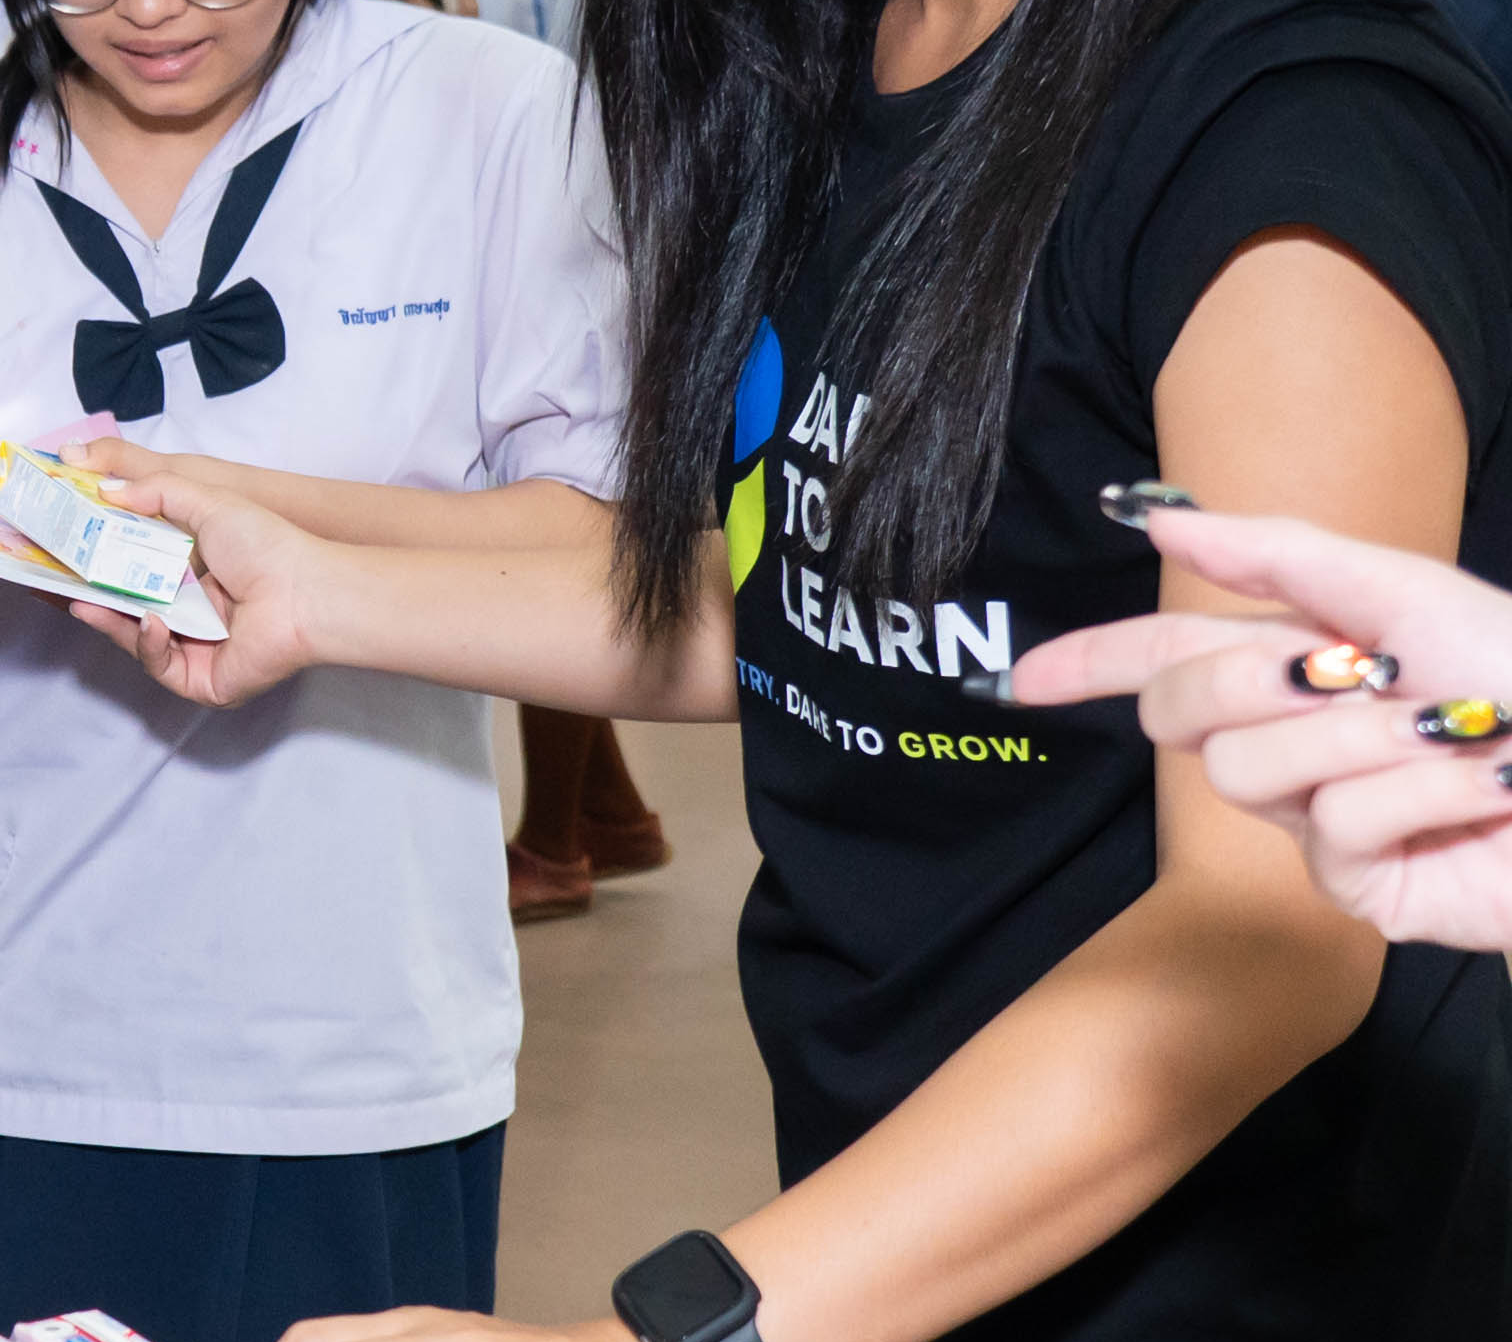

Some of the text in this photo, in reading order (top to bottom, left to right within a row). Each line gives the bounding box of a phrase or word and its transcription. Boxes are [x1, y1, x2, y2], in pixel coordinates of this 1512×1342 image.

[787, 371, 872, 465] DA
[782, 459, 832, 553] TO
[781, 554, 1012, 678] LEARN
[836, 719, 885, 756] TO
[898, 731, 1048, 763] GROW.
